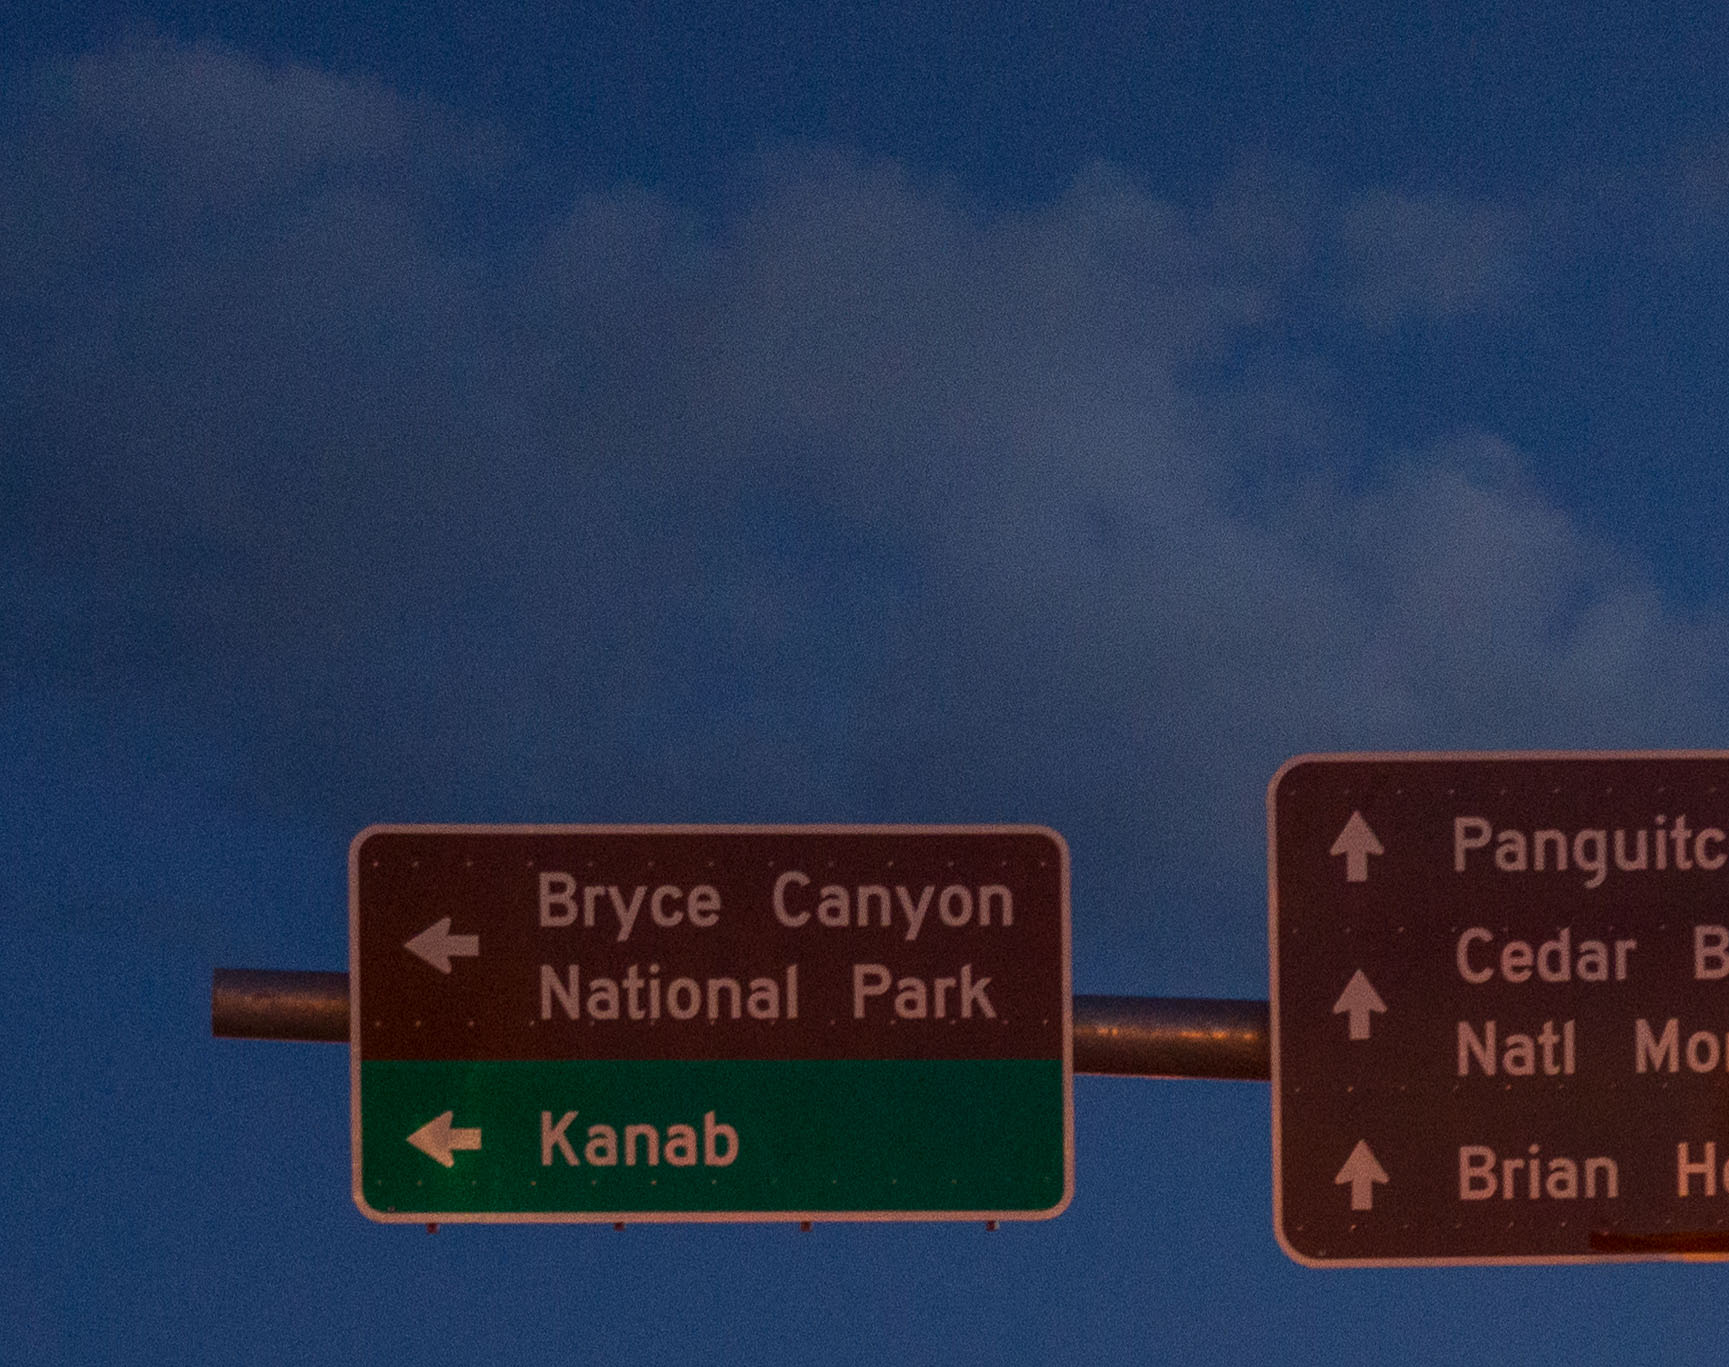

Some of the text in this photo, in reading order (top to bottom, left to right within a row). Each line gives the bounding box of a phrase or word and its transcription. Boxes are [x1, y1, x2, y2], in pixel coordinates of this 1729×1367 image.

[538, 871, 1013, 941] Bryce Canyon
[1456, 926, 1636, 984] Cedar
[539, 963, 997, 1020] National Park
[1457, 1019, 1576, 1077] Natl
[540, 1109, 740, 1167] Kanab
[1458, 1144, 1620, 1201] Brian
